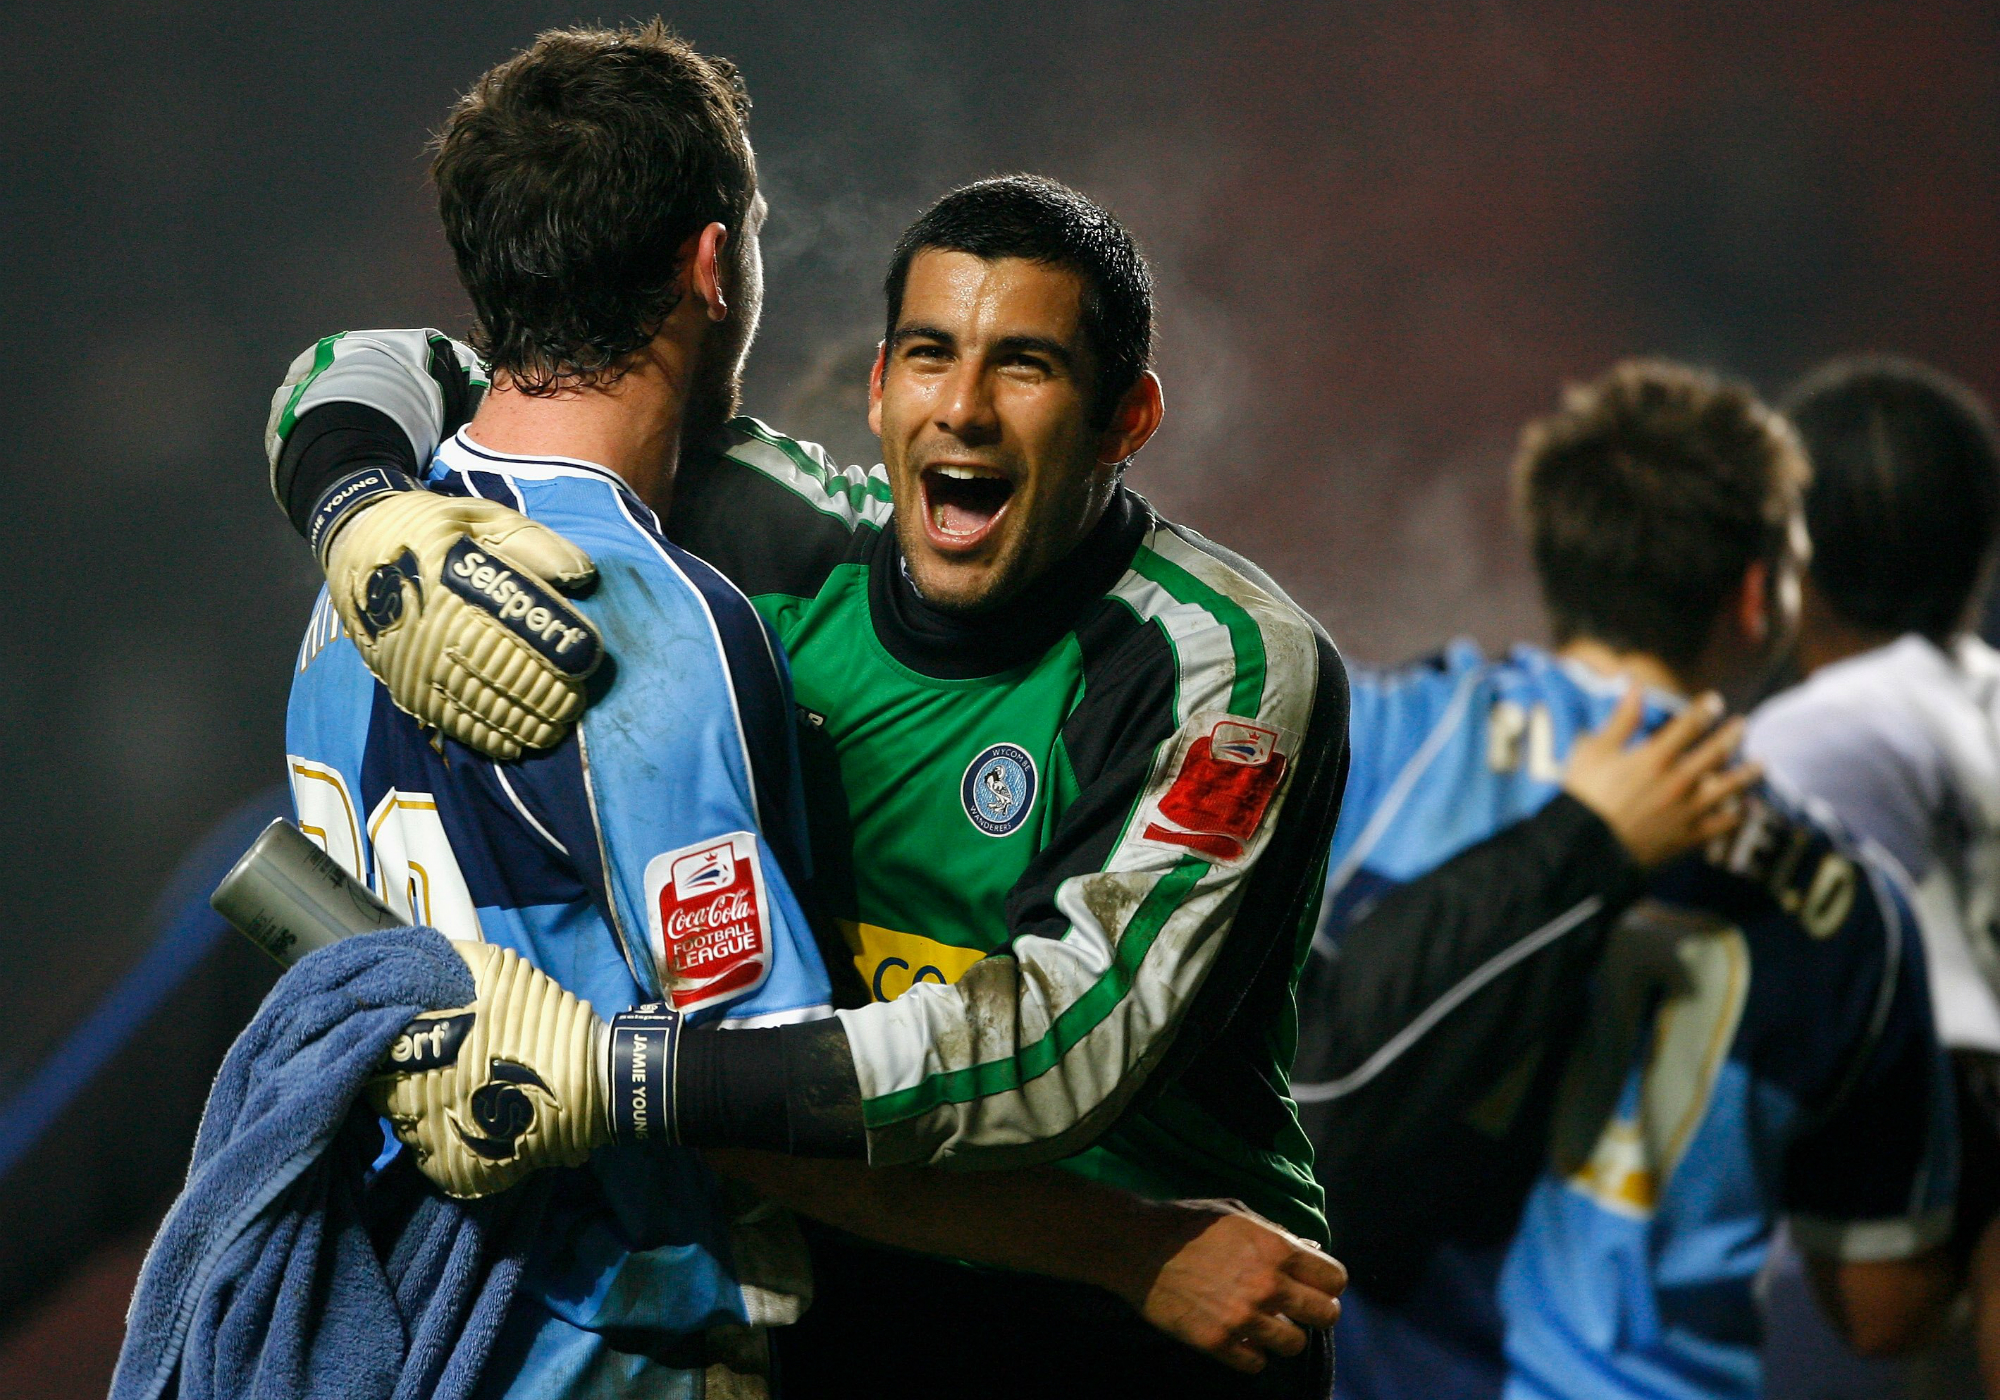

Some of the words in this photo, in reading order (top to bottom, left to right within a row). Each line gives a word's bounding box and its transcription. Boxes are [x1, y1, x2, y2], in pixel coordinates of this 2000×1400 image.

[323, 476, 379, 513] YOUNG
[453, 550, 583, 655] selsport
[991, 748, 1031, 772] WYCOMBE
[970, 805, 1012, 832] WANDERERS
[673, 921, 754, 956] FOOTBALL
[674, 932, 756, 971] LEAGUE
[631, 1033, 648, 1083] JAMIE
[631, 1086, 650, 1140] YOUNG
